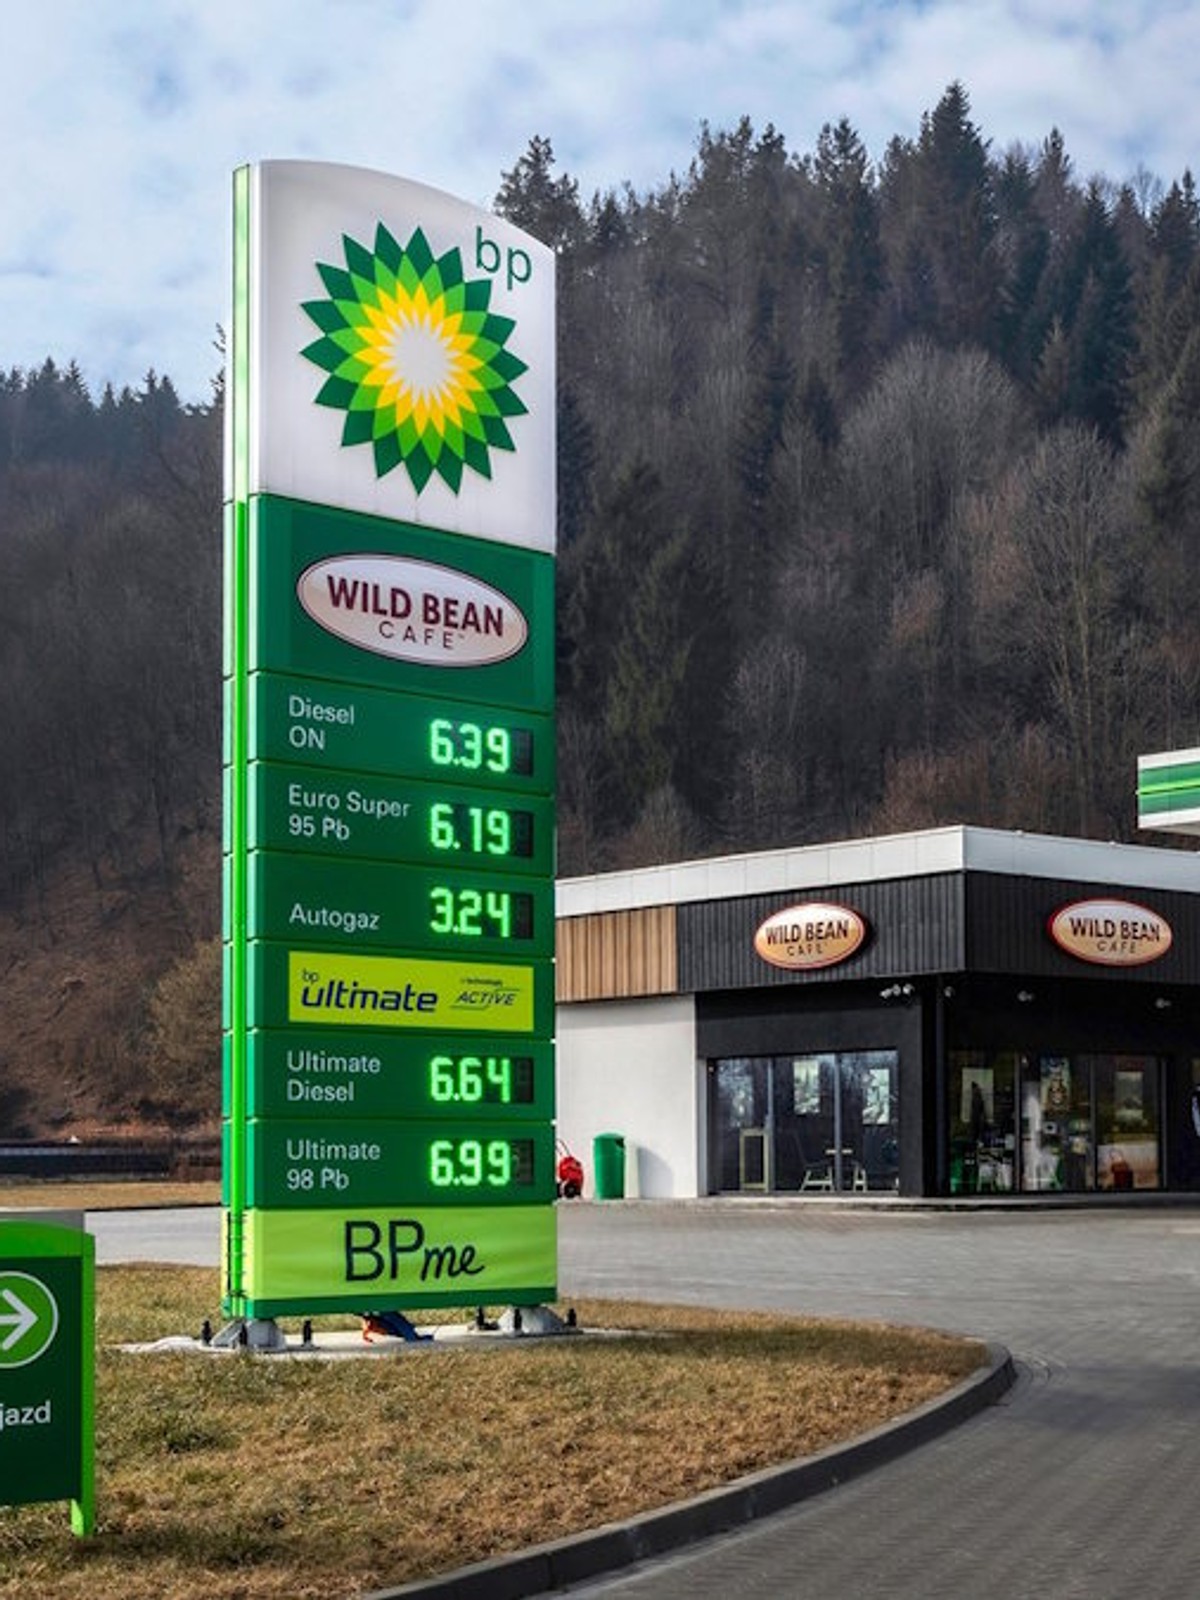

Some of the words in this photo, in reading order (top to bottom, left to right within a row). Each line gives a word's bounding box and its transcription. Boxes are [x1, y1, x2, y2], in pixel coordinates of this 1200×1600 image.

[476, 226, 532, 290] bp
[327, 574, 412, 619] WILD
[422, 592, 504, 637] BEAN
[379, 621, 454, 650] CAFE
[288, 695, 355, 725] Diesel
[288, 725, 326, 750] ON
[430, 718, 510, 774] 6.39
[288, 784, 340, 810] Euro
[346, 791, 411, 819] Super
[288, 815, 315, 836] 95
[322, 818, 351, 841] Pb
[430, 803, 510, 855] 6.19
[288, 903, 380, 932] Autogaz
[429, 886, 510, 938] 3.24
[765, 924, 801, 945] WILD
[805, 920, 849, 941] BEAN
[1069, 917, 1116, 938] WILD
[1120, 920, 1160, 942] BEAN
[301, 980, 438, 1013] ultimate
[286, 1050, 381, 1073] Ultimate
[286, 1079, 355, 1101] Diesel
[430, 1056, 510, 1103] 6.64
[286, 1139, 381, 1160] Ultimate
[430, 1140, 511, 1187] 6.99
[286, 1168, 314, 1190] 98
[320, 1167, 350, 1190] Pb
